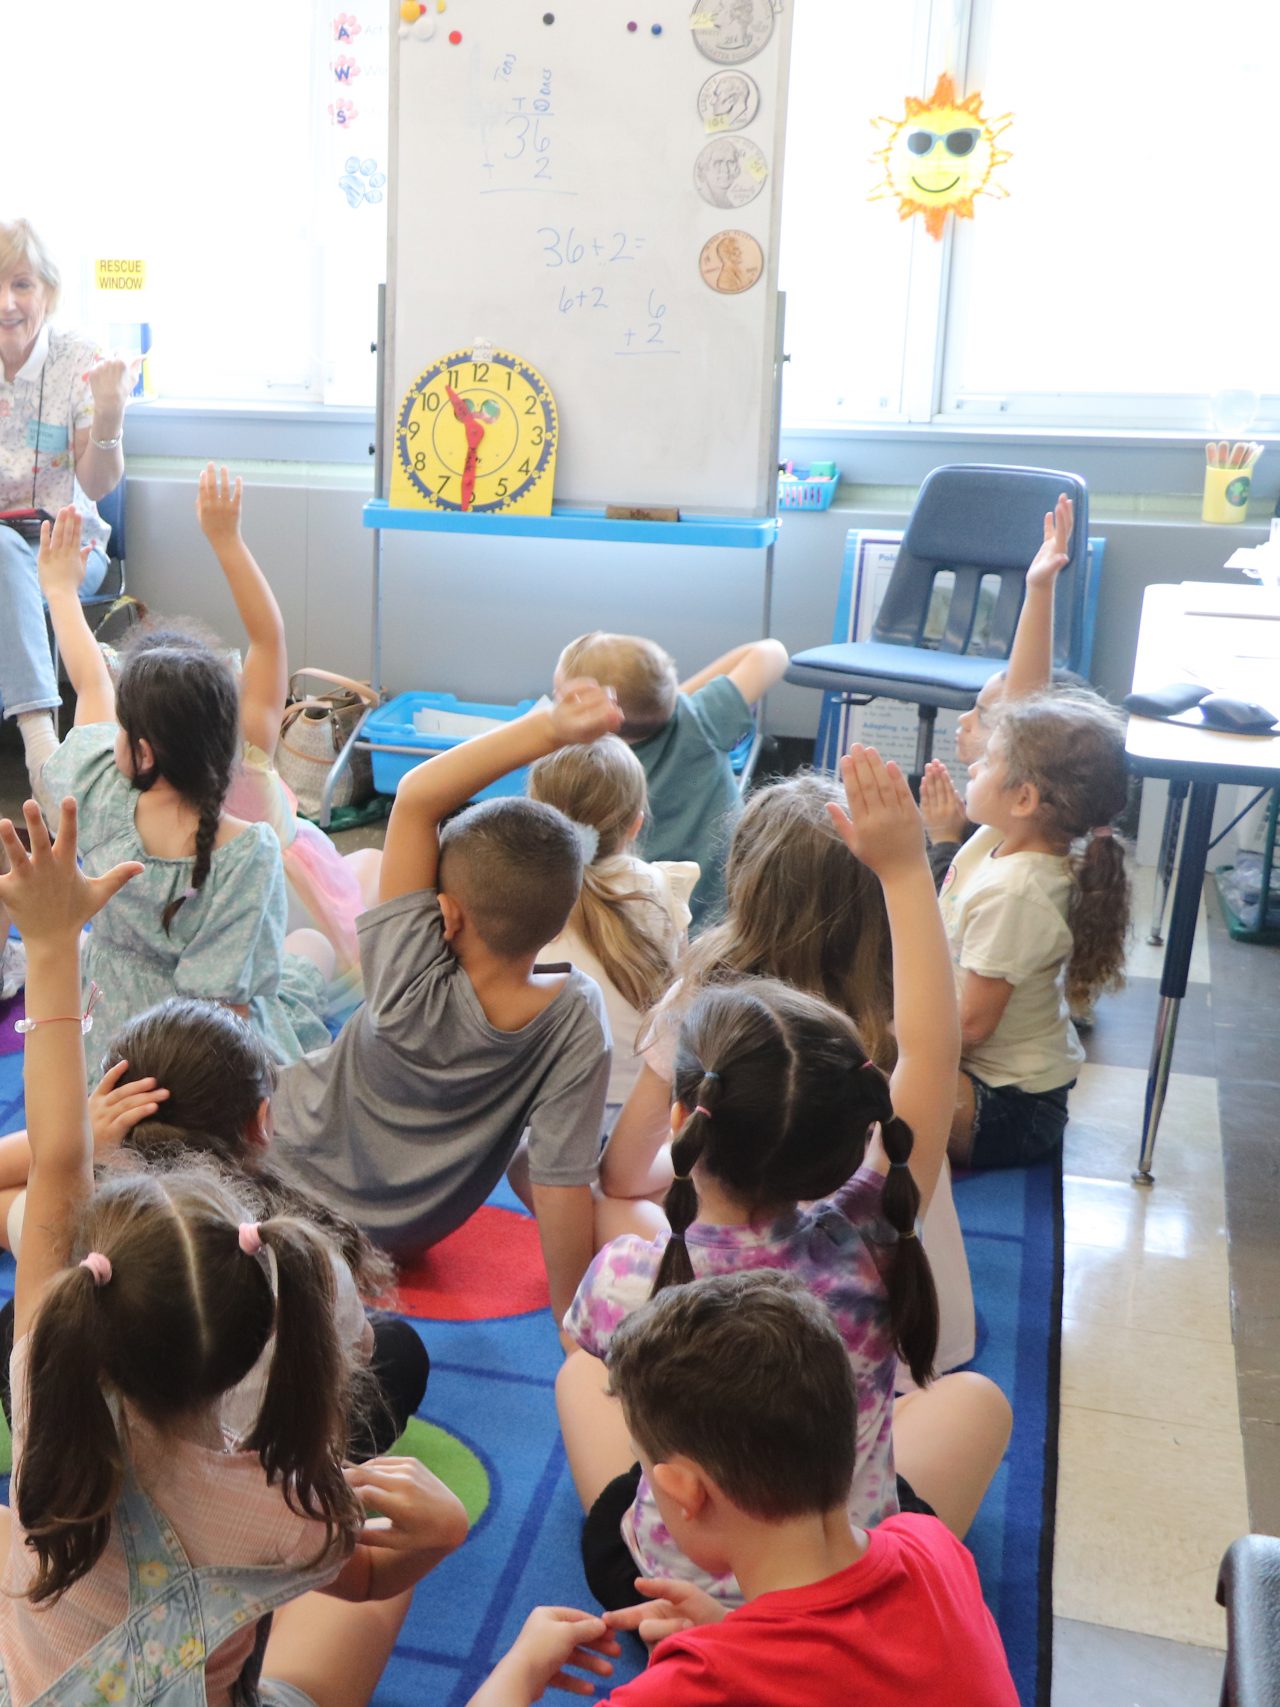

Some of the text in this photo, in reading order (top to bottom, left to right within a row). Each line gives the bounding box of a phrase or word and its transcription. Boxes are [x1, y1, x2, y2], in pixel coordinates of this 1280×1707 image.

[338, 25, 350, 40] A
[334, 66, 350, 81] W
[336, 110, 347, 124] S
[534, 156, 552, 179] 2
[100, 260, 141, 273] RESCUE
[100, 277, 142, 289] WINDOW
[648, 288, 666, 318] 6
[646, 322, 664, 344] 2
[447, 370, 460, 389] 11
[471, 363, 490, 382] 12
[506, 371, 513, 391] 1
[421, 392, 440, 412] 10
[525, 395, 538, 415] 2
[408, 421, 420, 441] 9
[531, 426, 544, 446] 3
[414, 452, 426, 471] 8
[517, 457, 531, 476] 4
[438, 475, 451, 494] 7
[495, 478, 509, 497] 5
